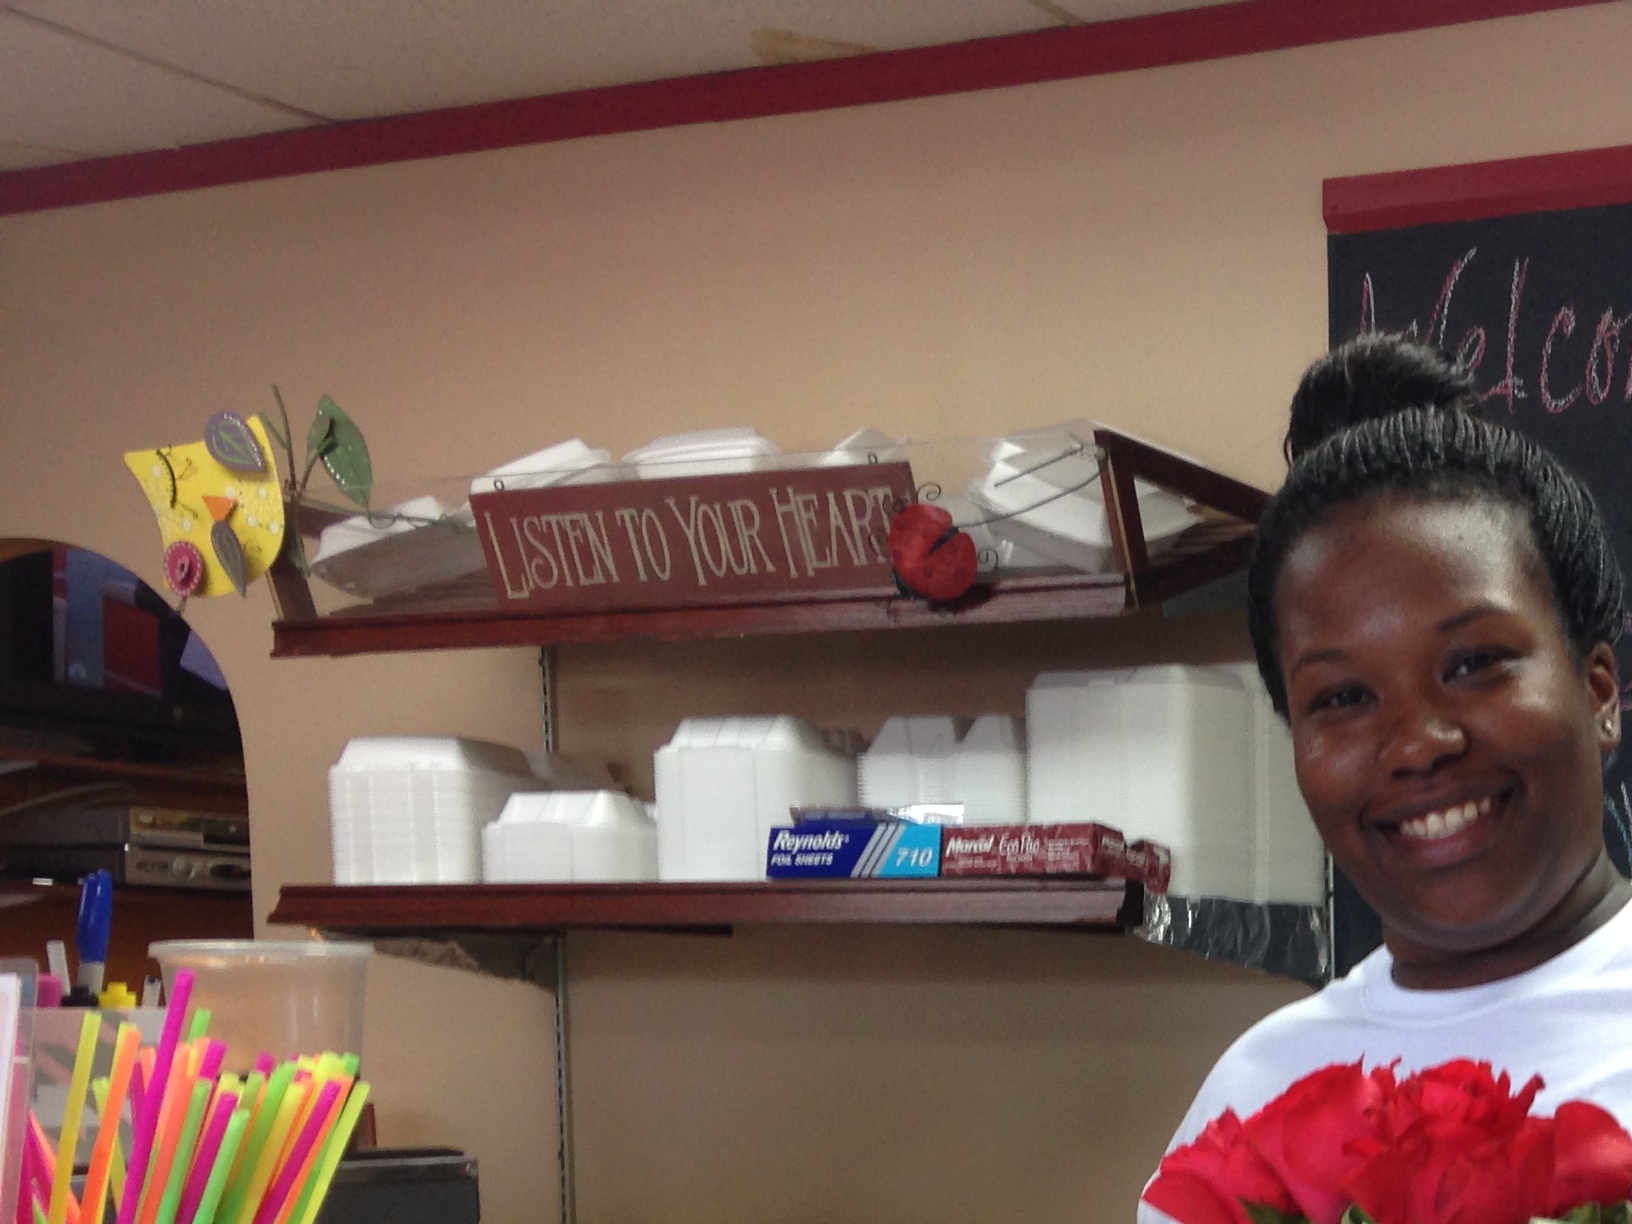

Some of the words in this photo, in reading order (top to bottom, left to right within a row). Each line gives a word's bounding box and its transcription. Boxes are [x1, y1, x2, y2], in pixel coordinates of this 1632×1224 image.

[484, 509, 620, 600] LISTEN
[616, 506, 673, 584] TO
[665, 493, 777, 587] YOUR
[773, 484, 894, 581] HEART
[772, 829, 846, 854] Reynolds
[770, 852, 793, 867] FOIL
[794, 851, 835, 867] SHEETS
[894, 846, 934, 868] 710
